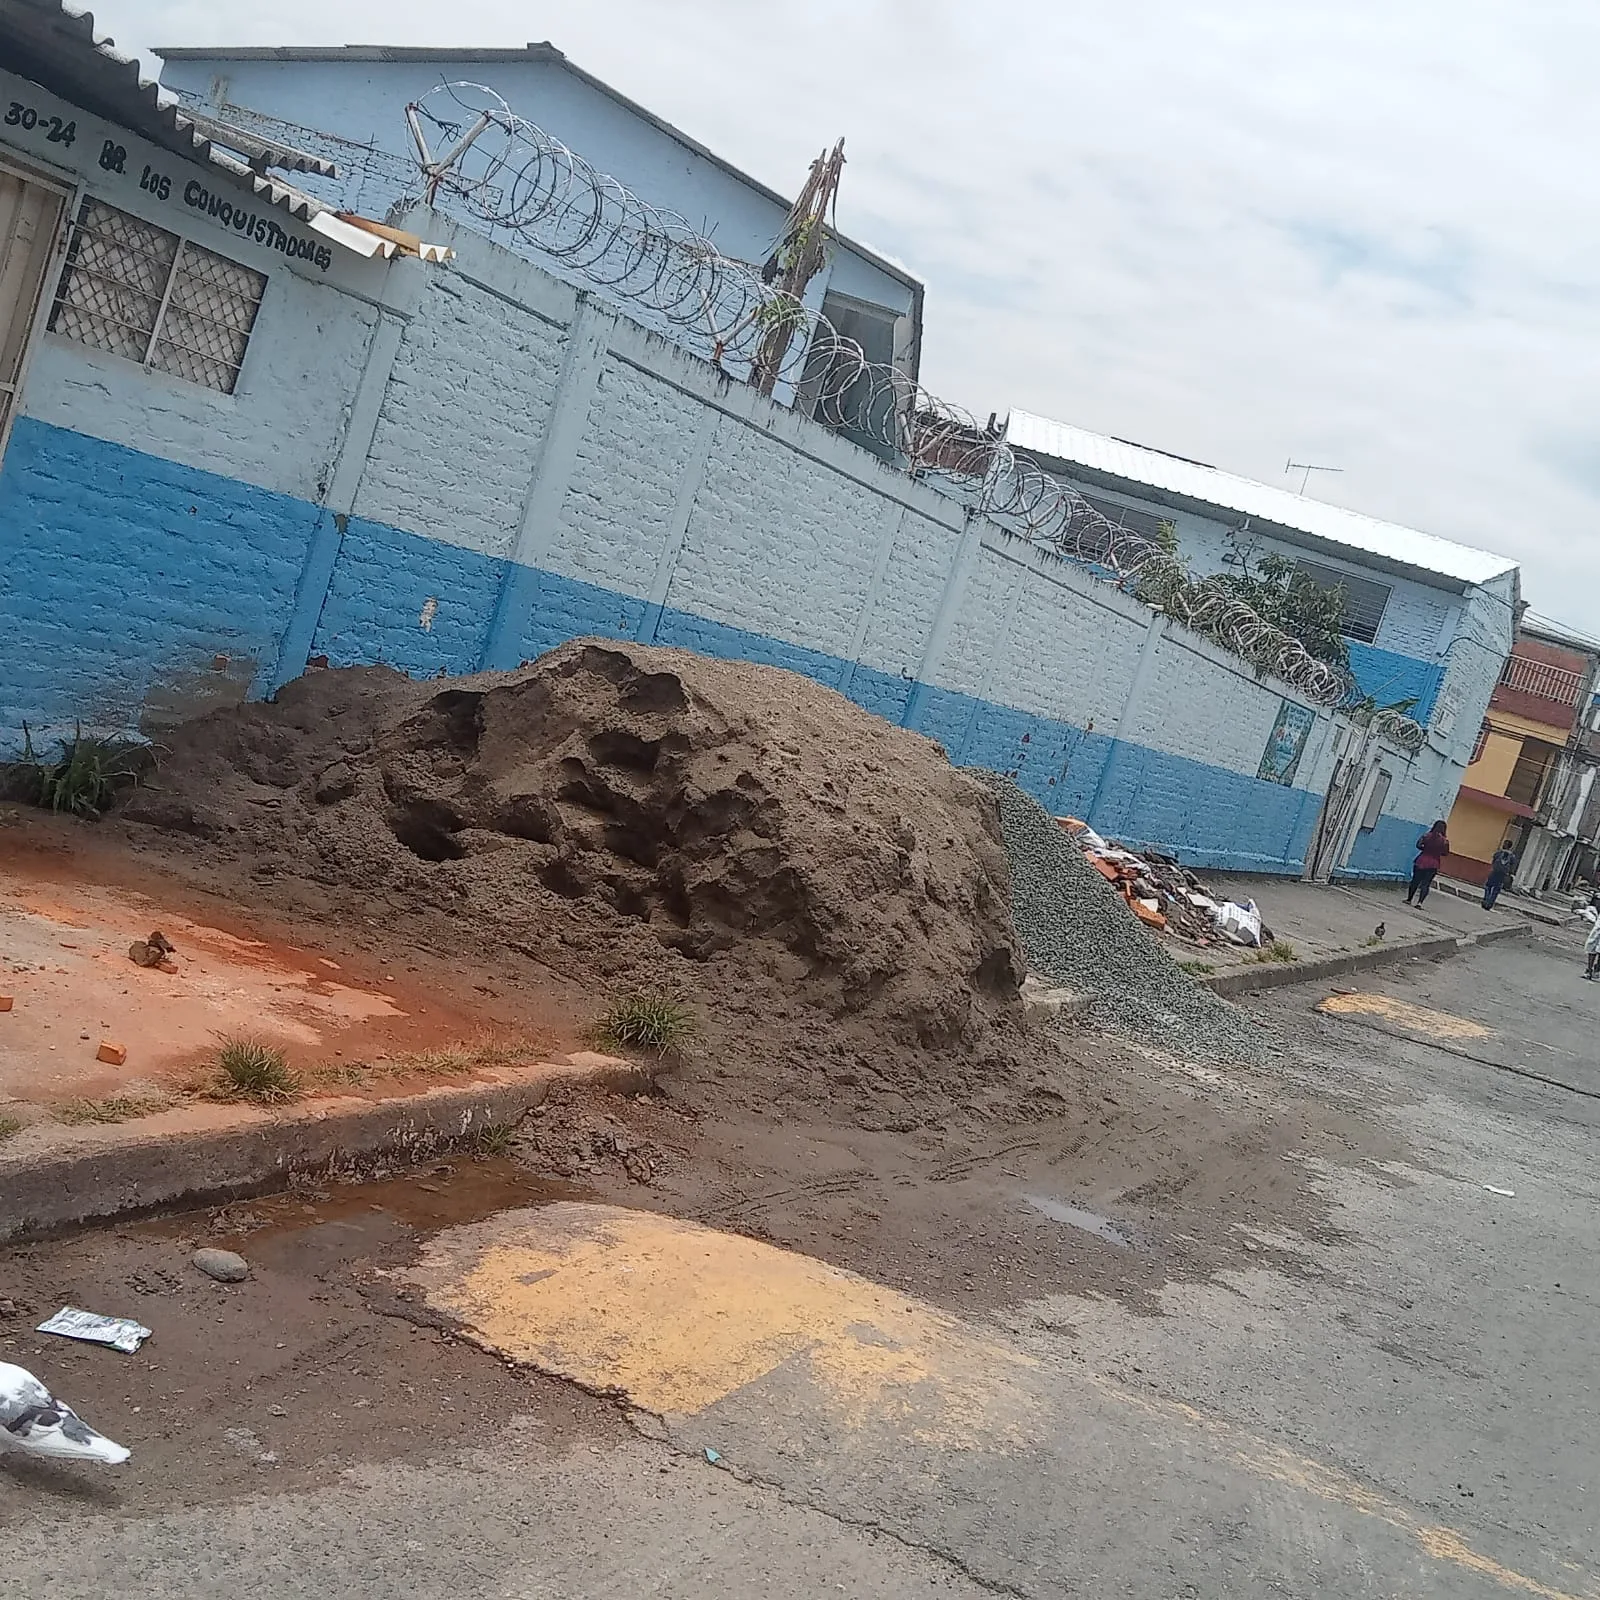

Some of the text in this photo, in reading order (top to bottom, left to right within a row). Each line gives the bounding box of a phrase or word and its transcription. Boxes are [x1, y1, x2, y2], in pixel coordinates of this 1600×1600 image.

[4, 102, 76, 148] 30-24
[139, 164, 171, 200] LOS
[183, 179, 332, 272] CONQUISTADORES
